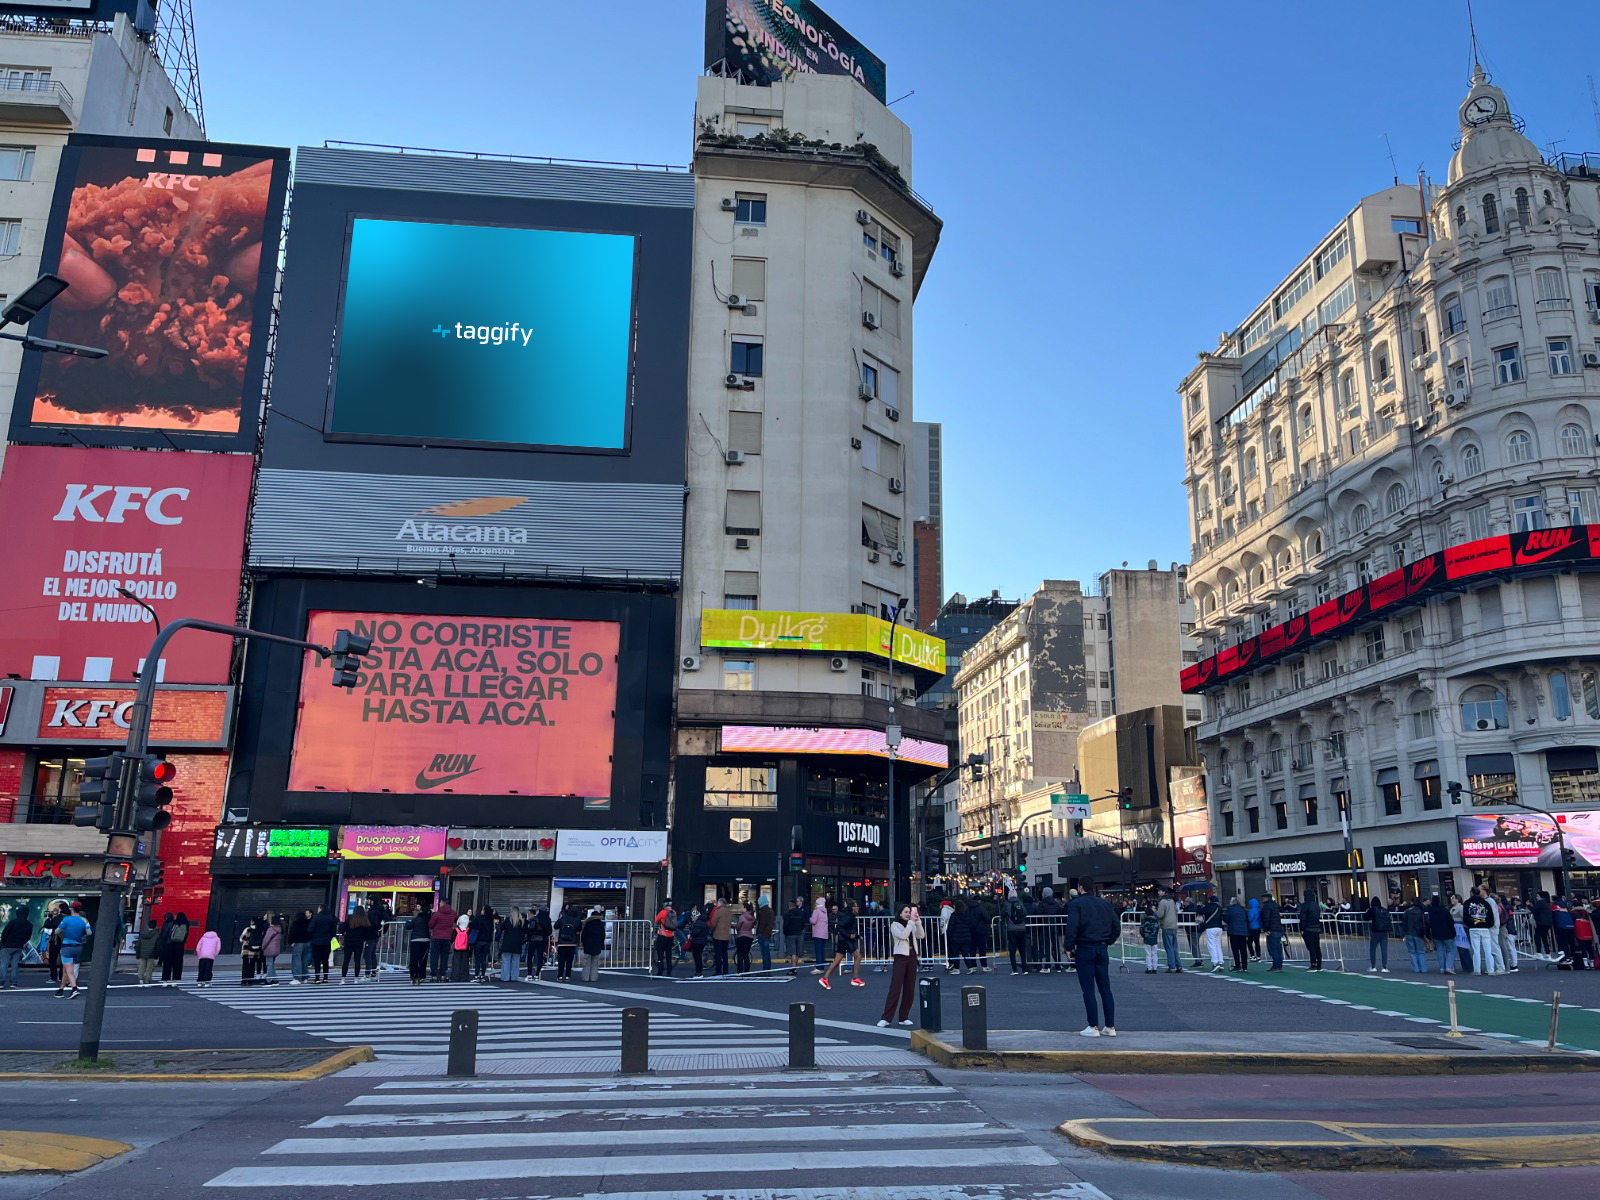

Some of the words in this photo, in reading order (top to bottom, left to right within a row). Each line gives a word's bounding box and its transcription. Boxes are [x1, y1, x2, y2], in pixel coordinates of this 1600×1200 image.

[757, 27, 818, 74] INDUM
[806, 49, 819, 65] EN
[142, 172, 202, 191] KFC
[455, 321, 534, 346] taggify
[53, 484, 190, 525] KFC
[395, 519, 528, 544] Atacama
[1525, 527, 1572, 551] RUN
[406, 544, 439, 553] Buenos
[441, 546, 467, 555] Aires,
[470, 547, 515, 555] Argentina
[63, 548, 163, 575] DISFRUTÁ
[1411, 555, 1436, 581] RUN
[42, 577, 61, 596] EL
[65, 578, 119, 598] MEJOR
[124, 580, 177, 600] POLLO
[1344, 588, 1363, 611] RUN
[58, 602, 88, 621] DEL
[92, 603, 154, 623] MUNDO
[354, 619, 402, 644] NO
[410, 621, 571, 649] CORRISTE
[314, 644, 423, 671] HSTA
[432, 645, 508, 677] ACÁ,
[516, 650, 603, 675] SOLO
[346, 672, 435, 697] PARA
[444, 674, 569, 700] LLEGAR
[48, 699, 136, 729] KFC
[362, 697, 471, 724] HASTA
[478, 695, 555, 727] ACÁ.
[428, 754, 475, 773] RUN
[356, 835, 405, 846] Drugstores
[407, 835, 421, 845] 24
[463, 838, 494, 851] LOVE
[497, 839, 538, 851] CHUKA
[837, 820, 881, 847] TOSTADO
[1463, 840, 1482, 850] MENÚ
[1497, 841, 1506, 850] LA
[1507, 840, 1539, 849] PELÍCULA
[847, 845, 858, 853] CAFÉ
[1384, 851, 1435, 866] McDonald's
[10, 859, 73, 878] KFC
[1270, 861, 1307, 873] McDonald's
[355, 879, 385, 887] Internet
[394, 879, 429, 887] Locutorio
[589, 880, 628, 889] OPTICA
